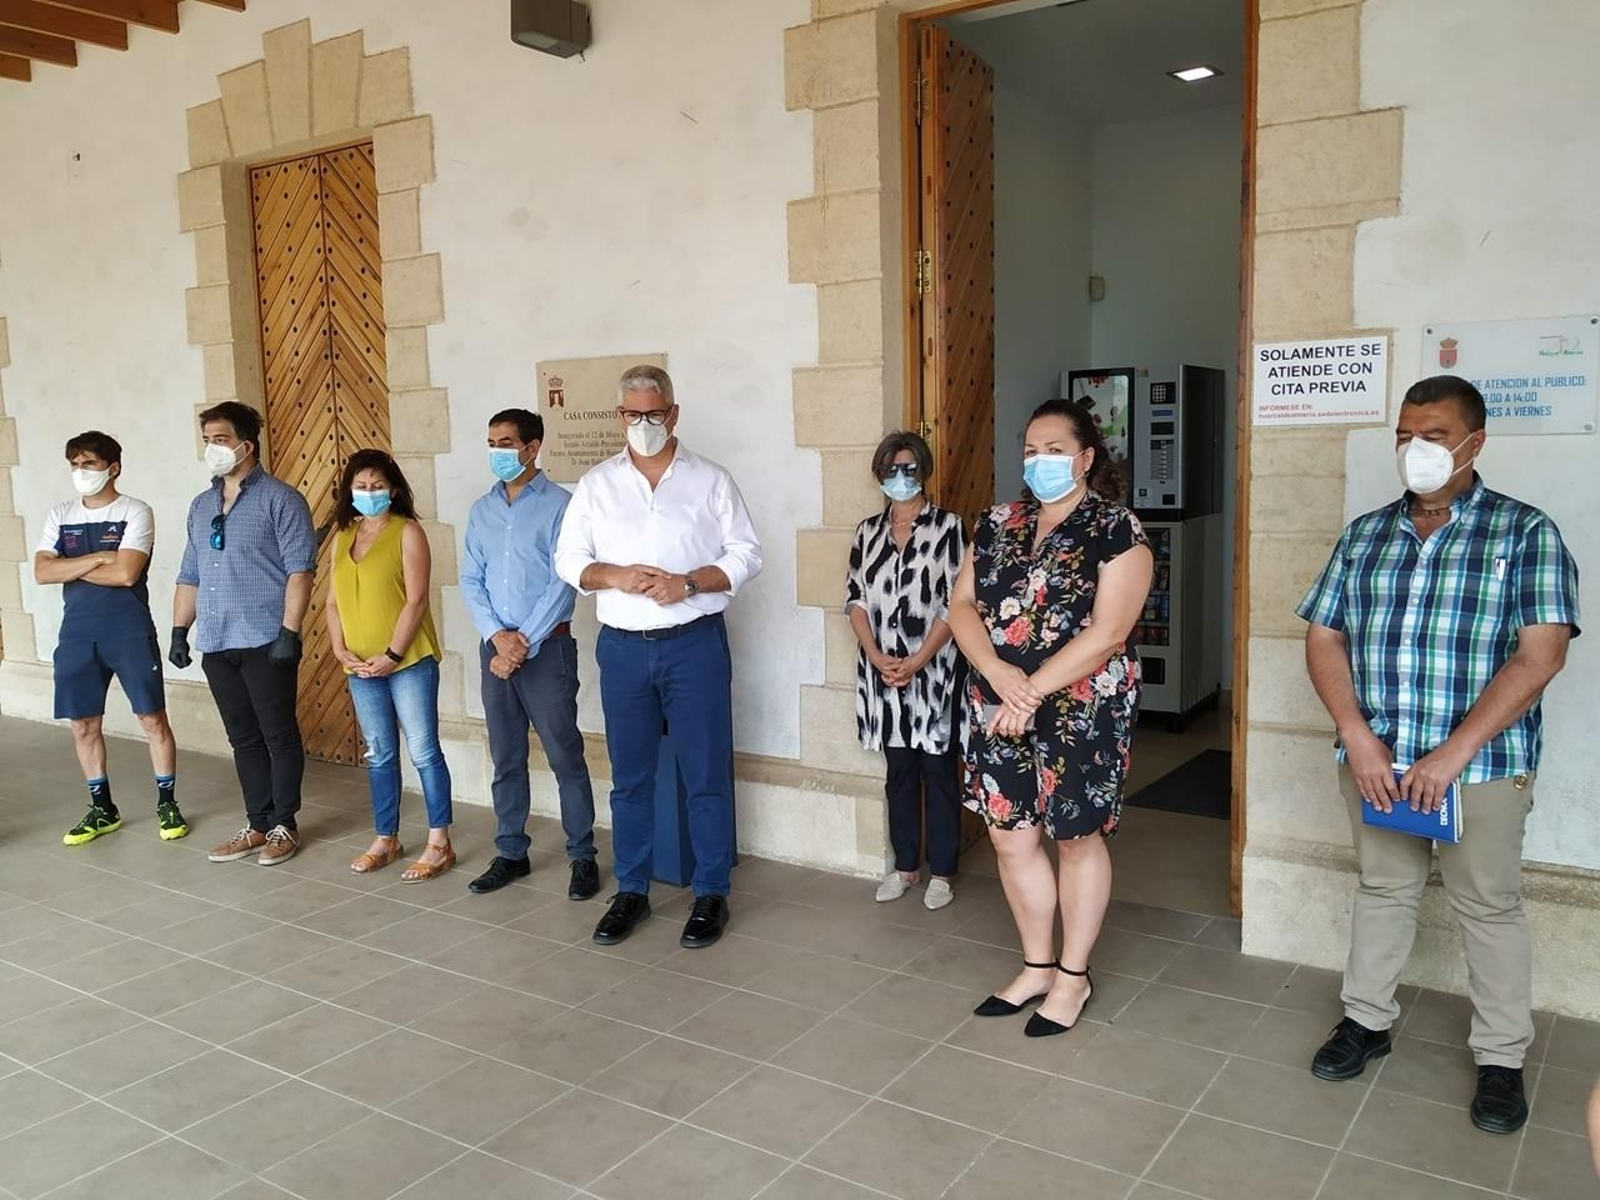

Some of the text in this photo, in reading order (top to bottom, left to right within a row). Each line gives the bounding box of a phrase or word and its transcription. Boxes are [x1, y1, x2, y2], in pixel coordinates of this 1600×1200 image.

[1260, 343, 1381, 361] SOLAMENTE SE
[1268, 362, 1372, 378] ATIENDE CON
[1271, 380, 1367, 395] CITA PREVIA
[1484, 378, 1529, 389] ATENCION
[1531, 377, 1542, 388] AL
[1504, 393, 1511, 402] A
[1513, 392, 1537, 402] 14:00
[563, 410, 617, 420] CASA CONSISTO
[1505, 406, 1511, 416] A
[1514, 405, 1552, 416] VIERNES
